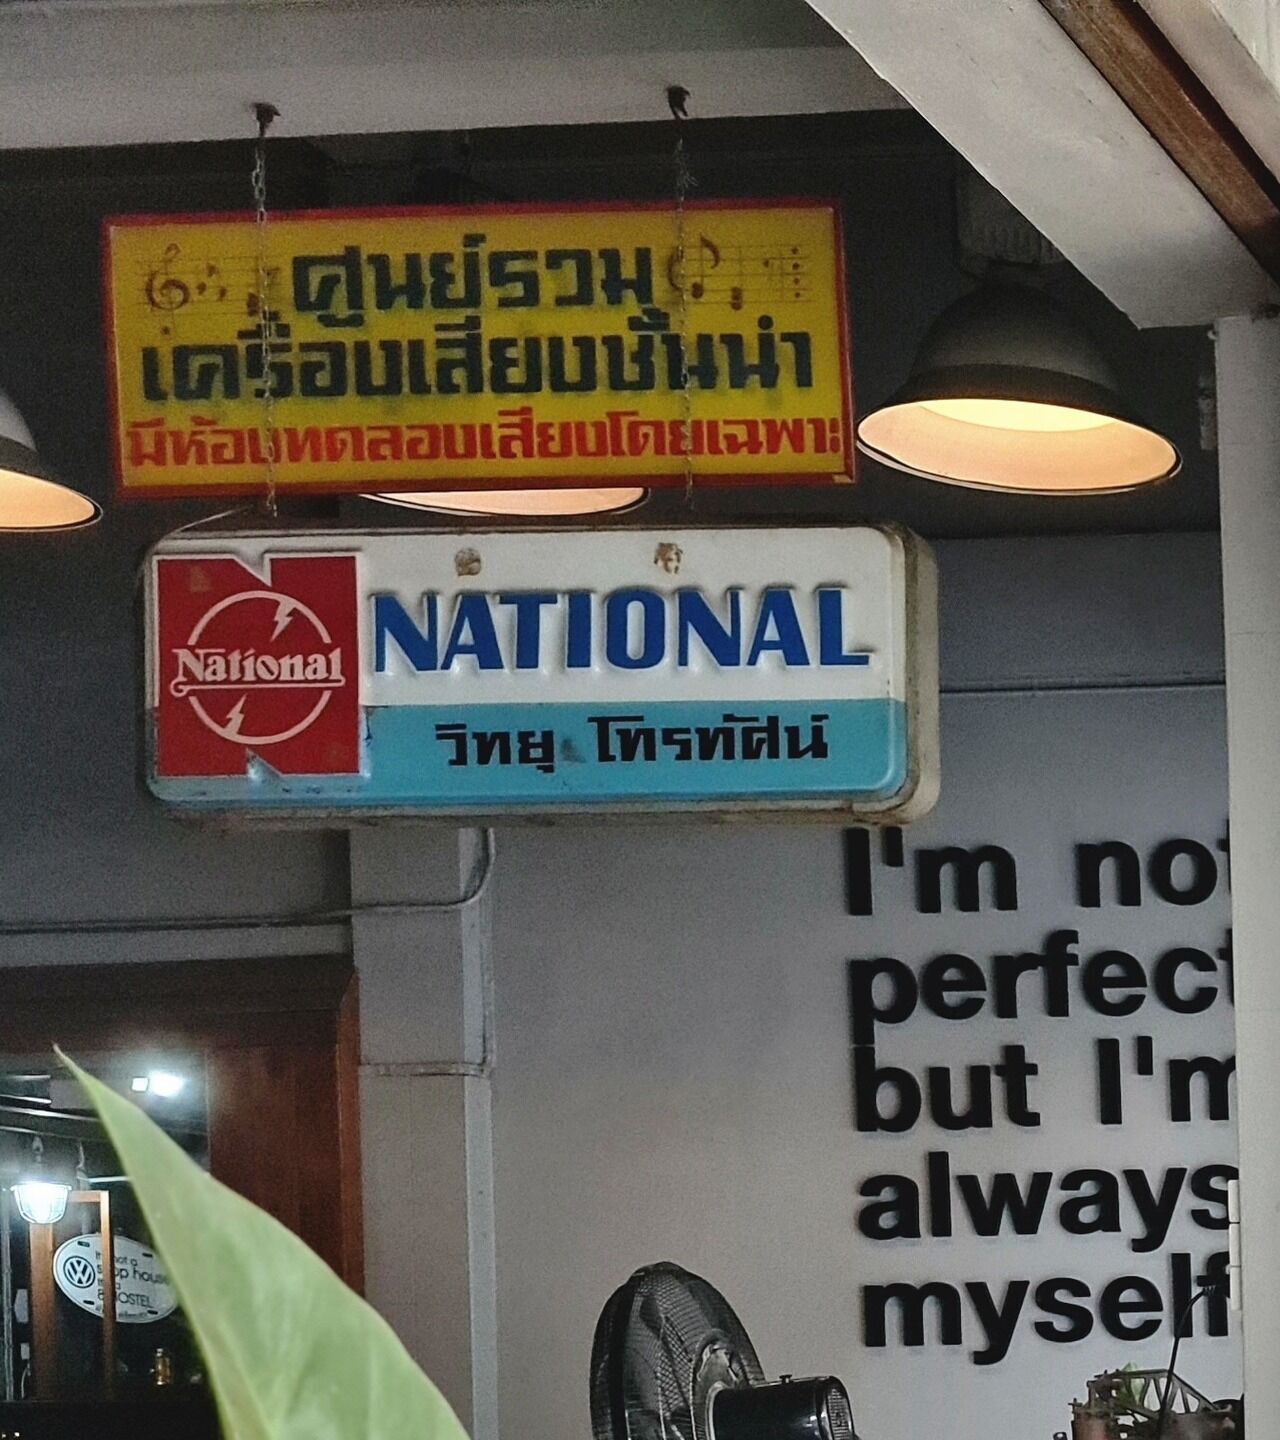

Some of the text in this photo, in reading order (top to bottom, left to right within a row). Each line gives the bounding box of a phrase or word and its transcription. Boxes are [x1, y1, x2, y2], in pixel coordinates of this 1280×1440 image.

[291, 233, 654, 328] ศูนย์รวม
[140, 308, 813, 401] เครื่องเสียงชั้นนำ
[126, 406, 842, 468] มีห้องทดลองเสียงโดยเฉพาะ
[171, 646, 345, 697] National
[373, 586, 870, 675] NATIONAL
[434, 711, 829, 774] วิทยุ โทรทัศน์
[843, 819, 1230, 915] I'm no
[855, 1035, 1236, 1133] but I'm
[858, 1151, 1240, 1253] always
[118, 1291, 154, 1309] OSTEL
[863, 1252, 1230, 1366] myself
